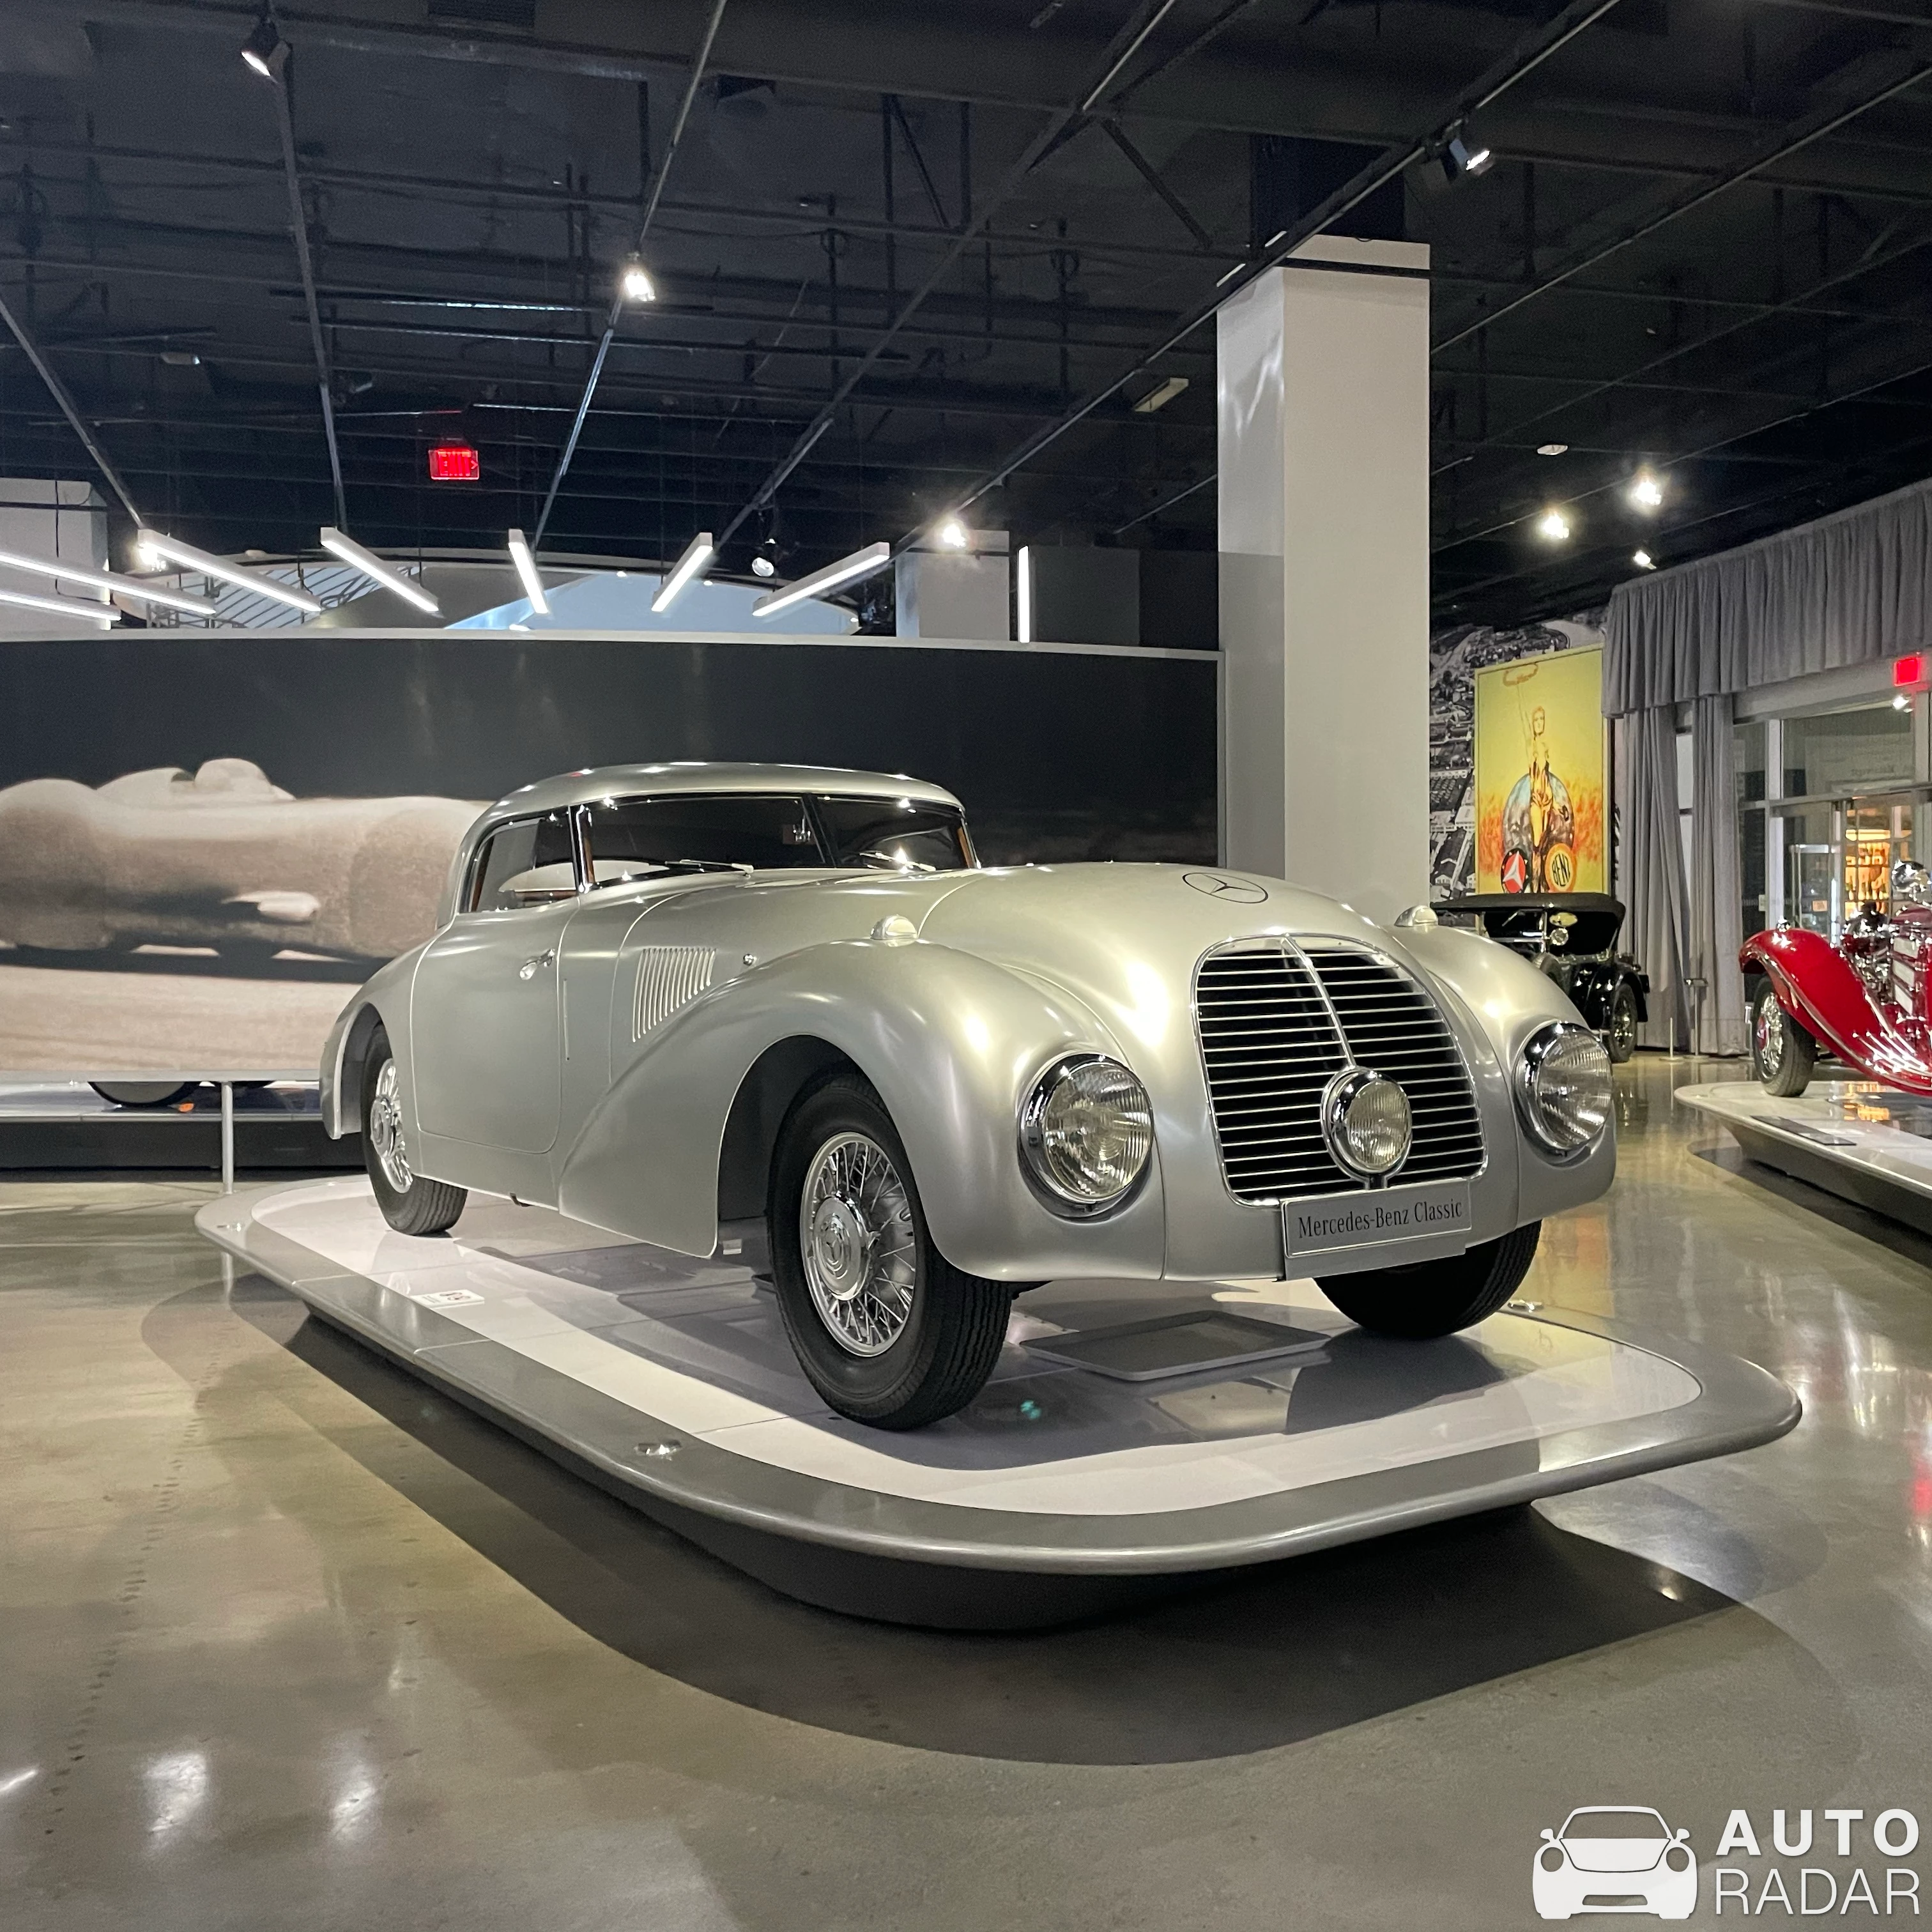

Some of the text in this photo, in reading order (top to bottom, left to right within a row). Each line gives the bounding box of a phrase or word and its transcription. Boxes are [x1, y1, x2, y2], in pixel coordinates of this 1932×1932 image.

[1552, 854, 1570, 886] BENZ
[1298, 1199, 1462, 1238] Mercedes-Benz Classic
